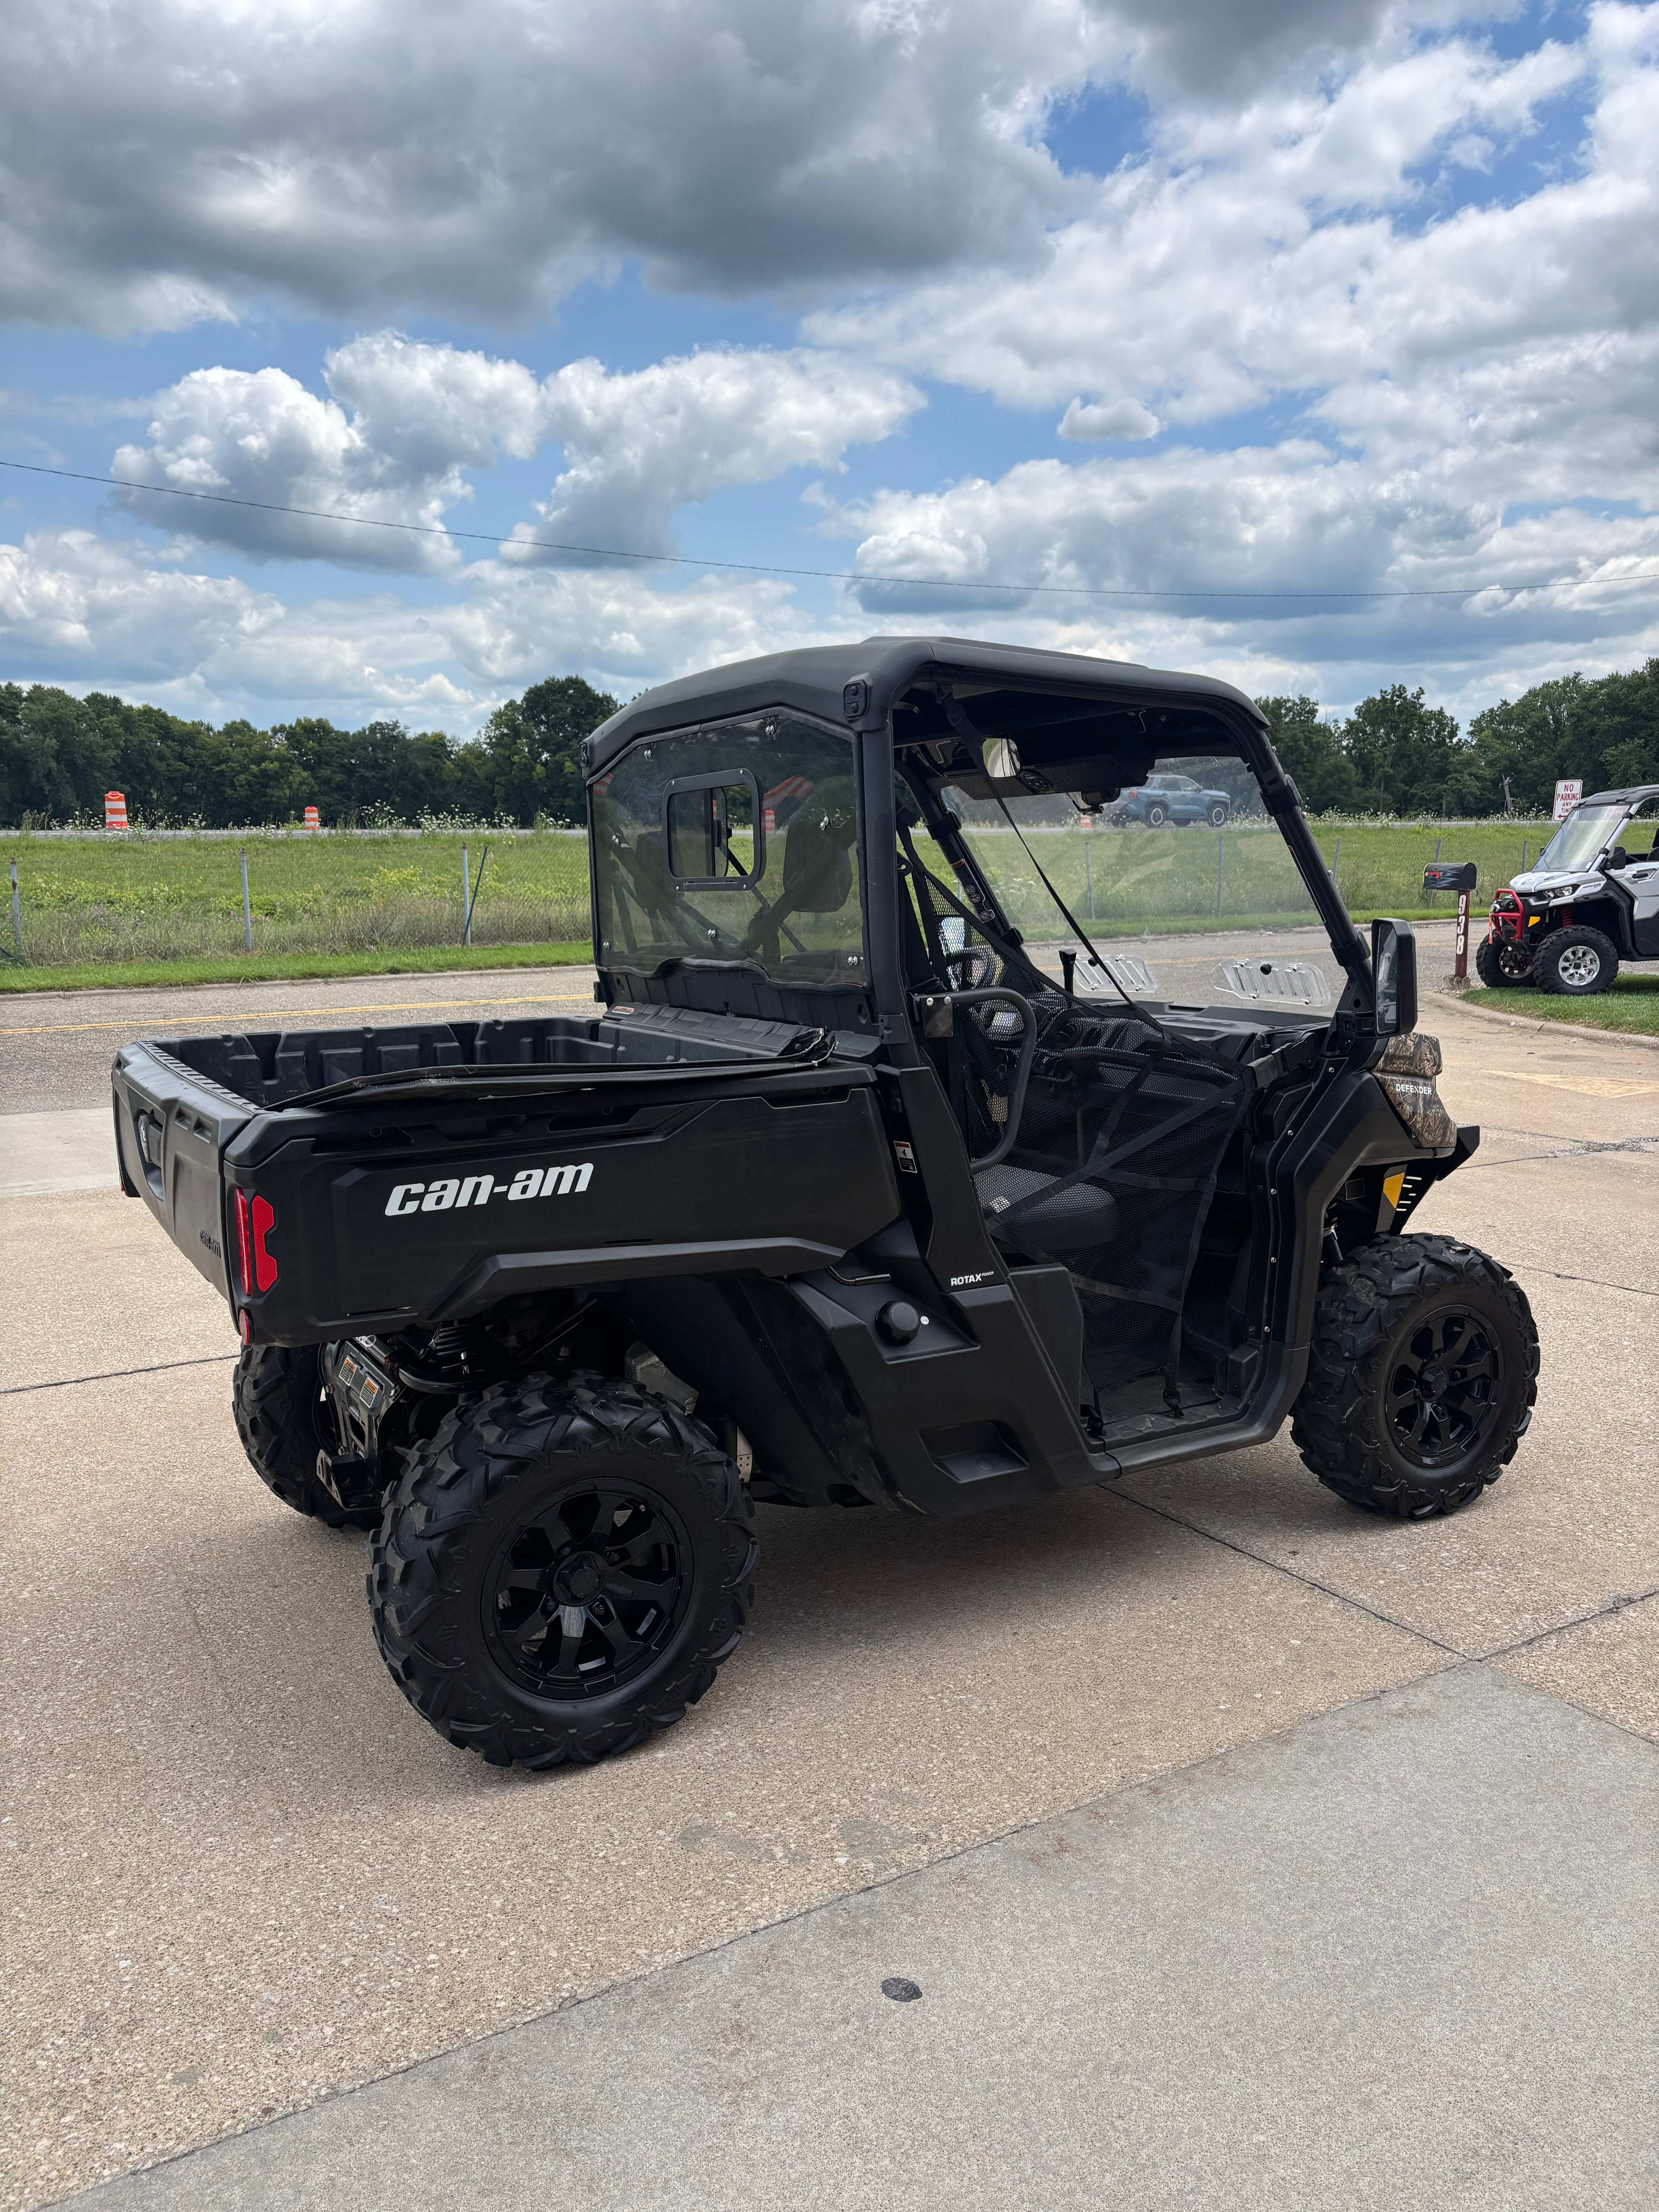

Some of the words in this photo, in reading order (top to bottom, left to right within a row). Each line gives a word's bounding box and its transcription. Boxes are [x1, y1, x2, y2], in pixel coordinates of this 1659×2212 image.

[1456, 895, 1466, 955] 938
[1396, 1084, 1432, 1095] DEFENDER
[385, 1163, 594, 1216] can-am
[951, 1273, 982, 1286] ROTAX
